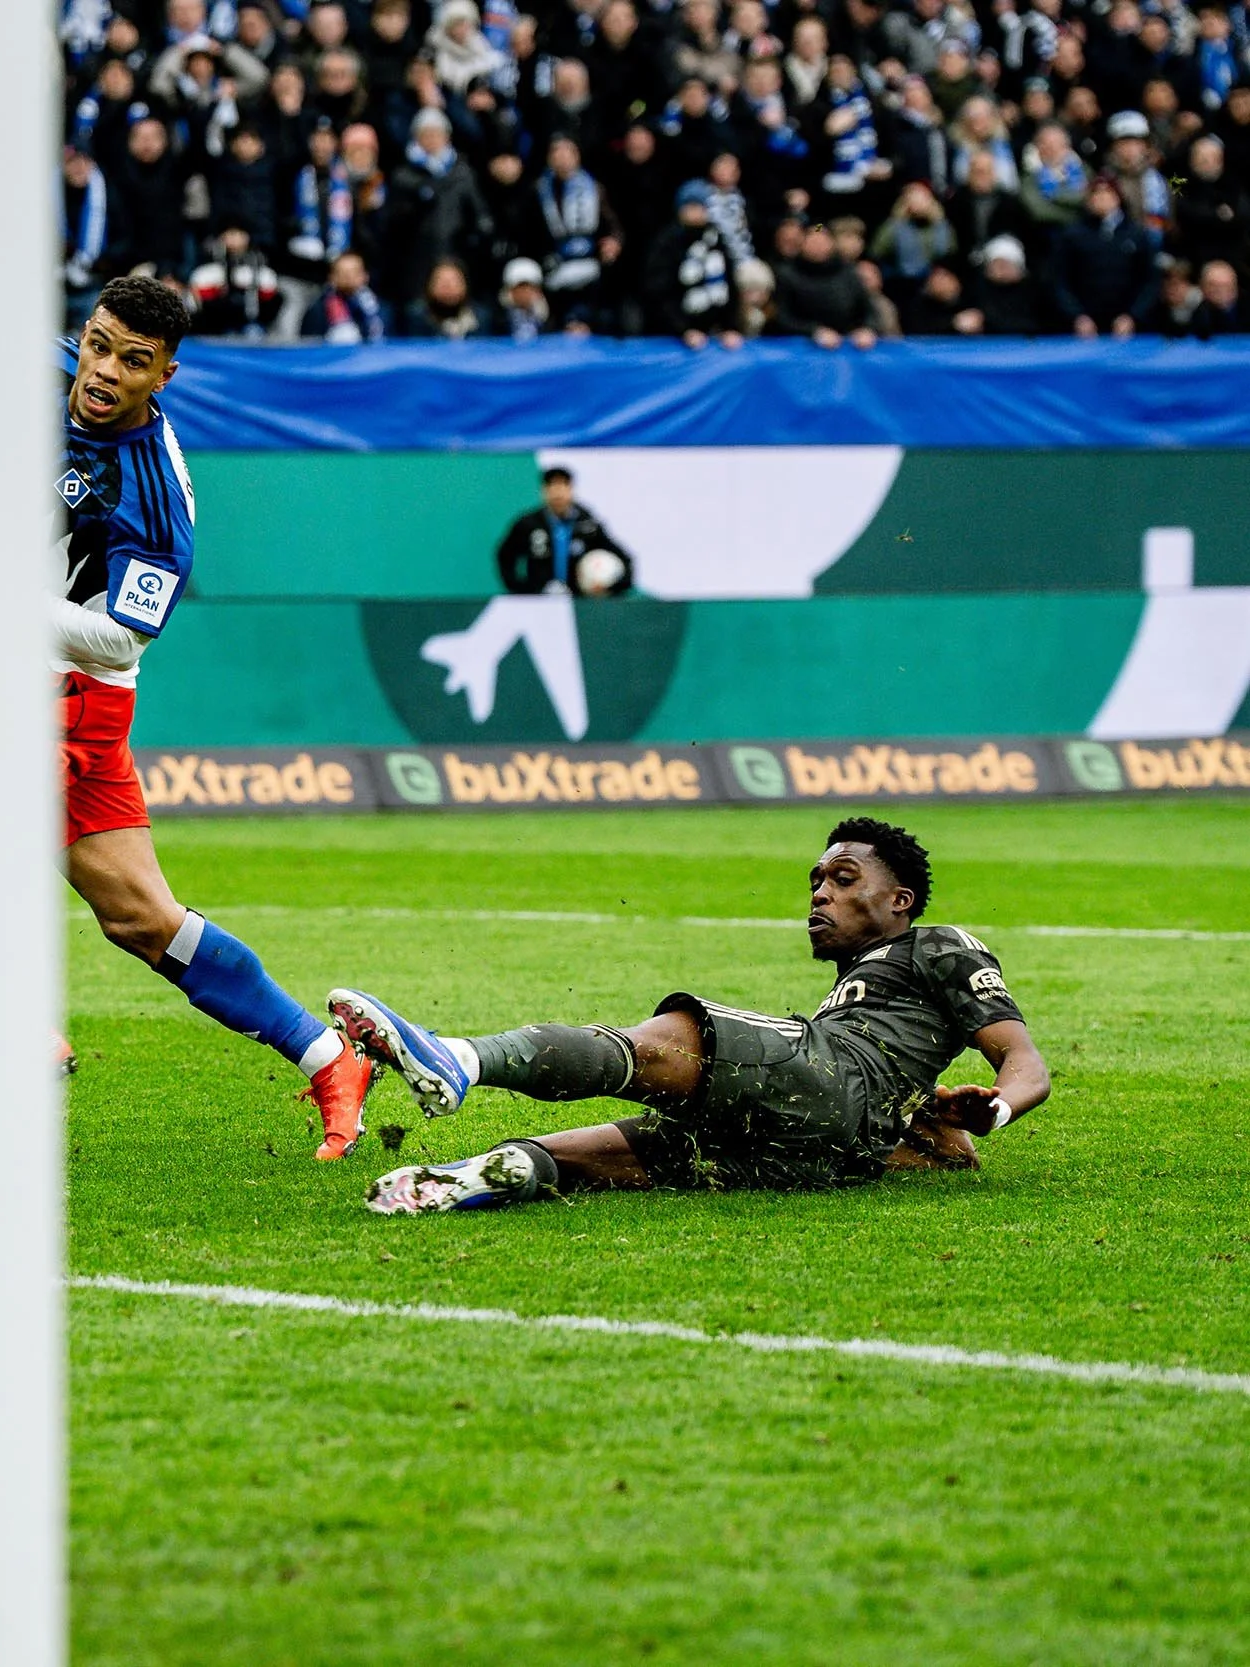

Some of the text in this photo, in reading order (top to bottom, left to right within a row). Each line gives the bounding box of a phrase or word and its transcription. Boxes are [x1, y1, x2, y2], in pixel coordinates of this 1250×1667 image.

[125, 591, 159, 612] PLAN
[135, 752, 354, 805] uXtrade
[443, 751, 699, 803] buXtrade
[784, 742, 1038, 798] buXtrade
[969, 968, 1007, 992] KER
